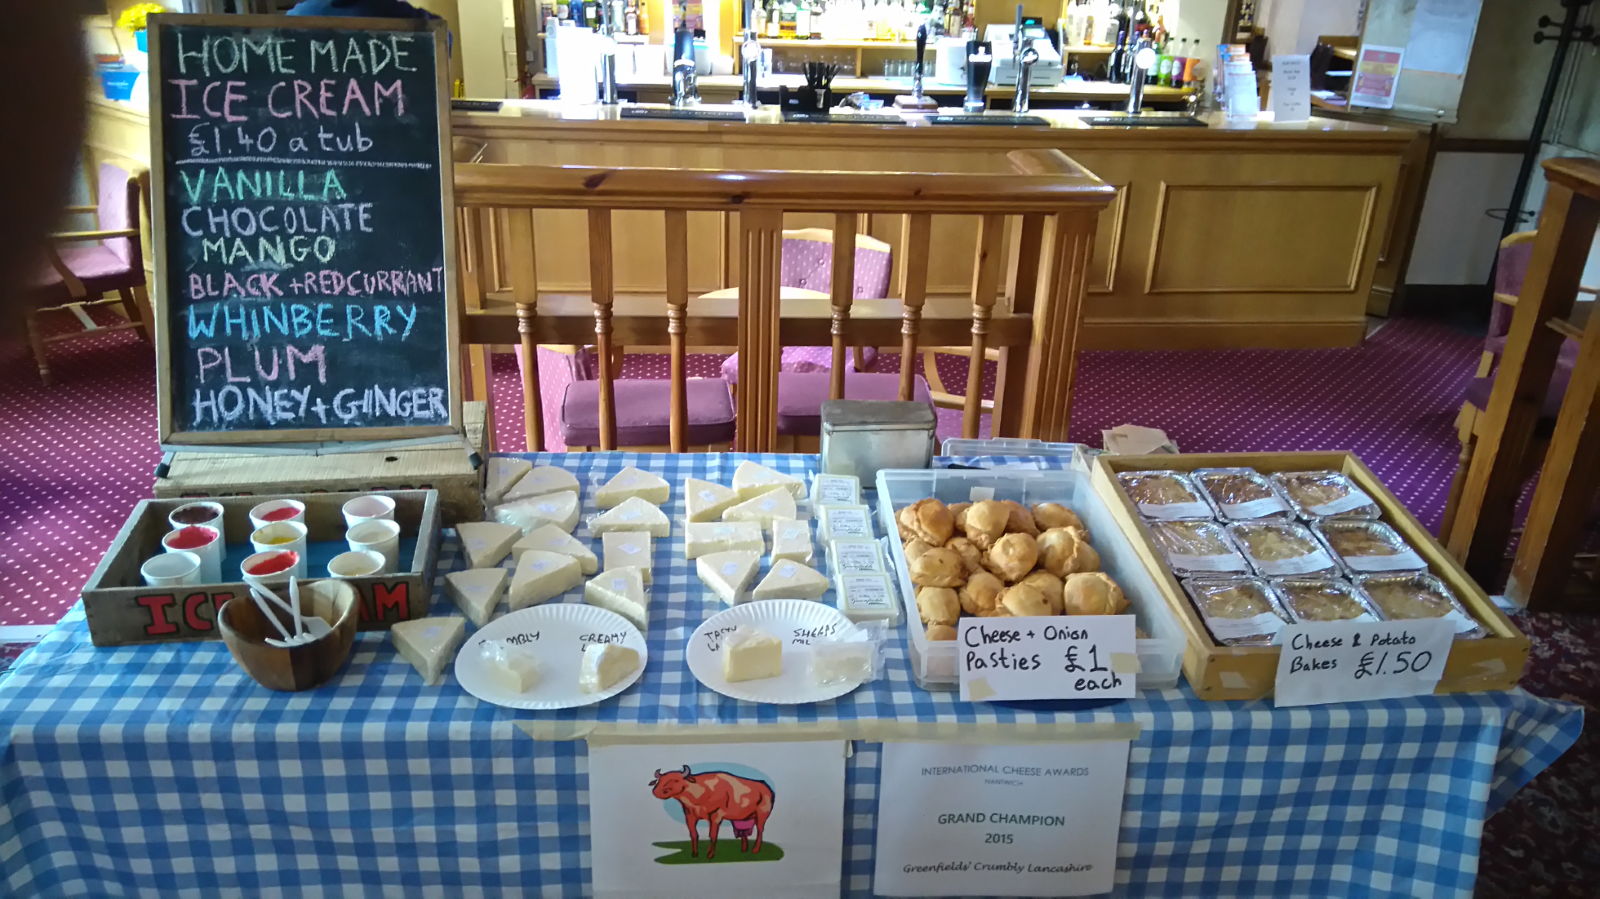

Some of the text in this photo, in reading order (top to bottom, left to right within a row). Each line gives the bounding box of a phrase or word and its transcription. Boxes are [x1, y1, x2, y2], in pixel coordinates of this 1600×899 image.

[177, 33, 417, 77] HOME MADE
[168, 78, 405, 122] ICE CREAM
[188, 122, 373, 157] £1.40 a tub
[180, 166, 347, 203] VANILLA
[181, 203, 374, 238] CHOCOLATE
[202, 234, 336, 265] MANGO
[188, 271, 284, 299] BLACK
[188, 302, 417, 342] WHINBERRY
[197, 344, 327, 384] PLUM
[579, 632, 627, 644] CREAMY
[965, 626, 1021, 647] Cheese
[1044, 626, 1089, 641] Onion
[1291, 631, 1416, 650] Cheese & Potato
[967, 644, 1107, 673] Pasties £1
[1290, 650, 1432, 679] Bakes £1.50
[1074, 672, 1122, 691] each
[921, 764, 1089, 776] INTERNATIONAL CHEESE AWARDS
[937, 812, 1065, 827] GRAND CHAMPION
[984, 832, 1014, 845] 2015
[974, 861, 1024, 873] Crumbly
[1027, 862, 1093, 874] Lancashire
